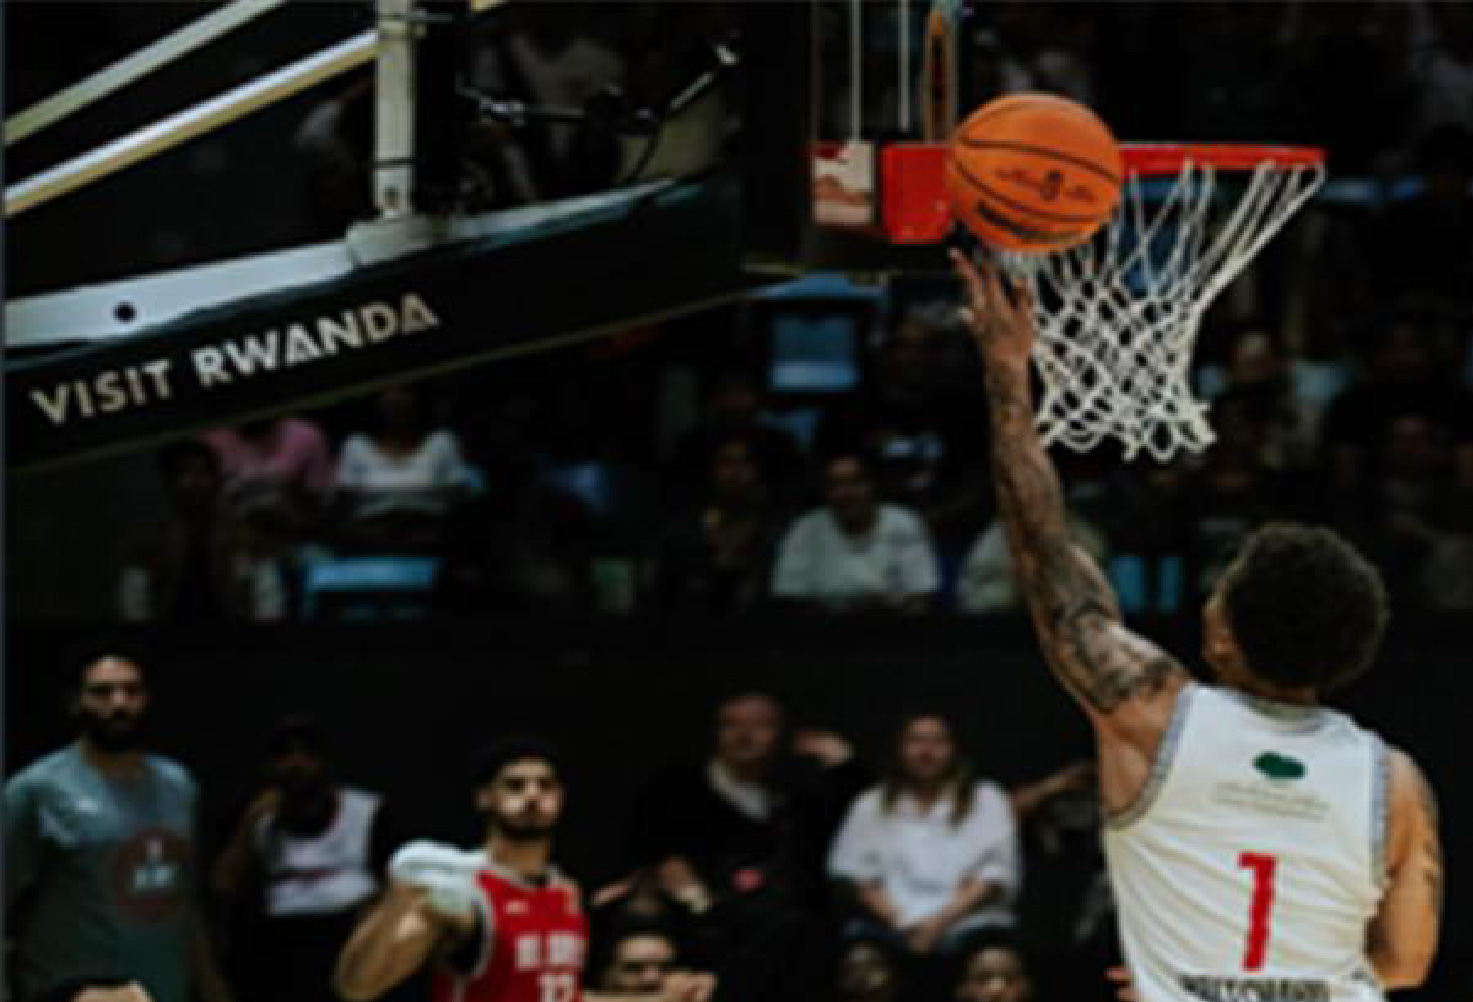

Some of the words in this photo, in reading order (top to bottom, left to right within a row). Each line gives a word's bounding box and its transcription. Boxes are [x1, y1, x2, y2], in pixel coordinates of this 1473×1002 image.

[29, 356, 173, 427] VISIT
[191, 292, 440, 389] RWANDA
[1237, 850, 1279, 974] 1
